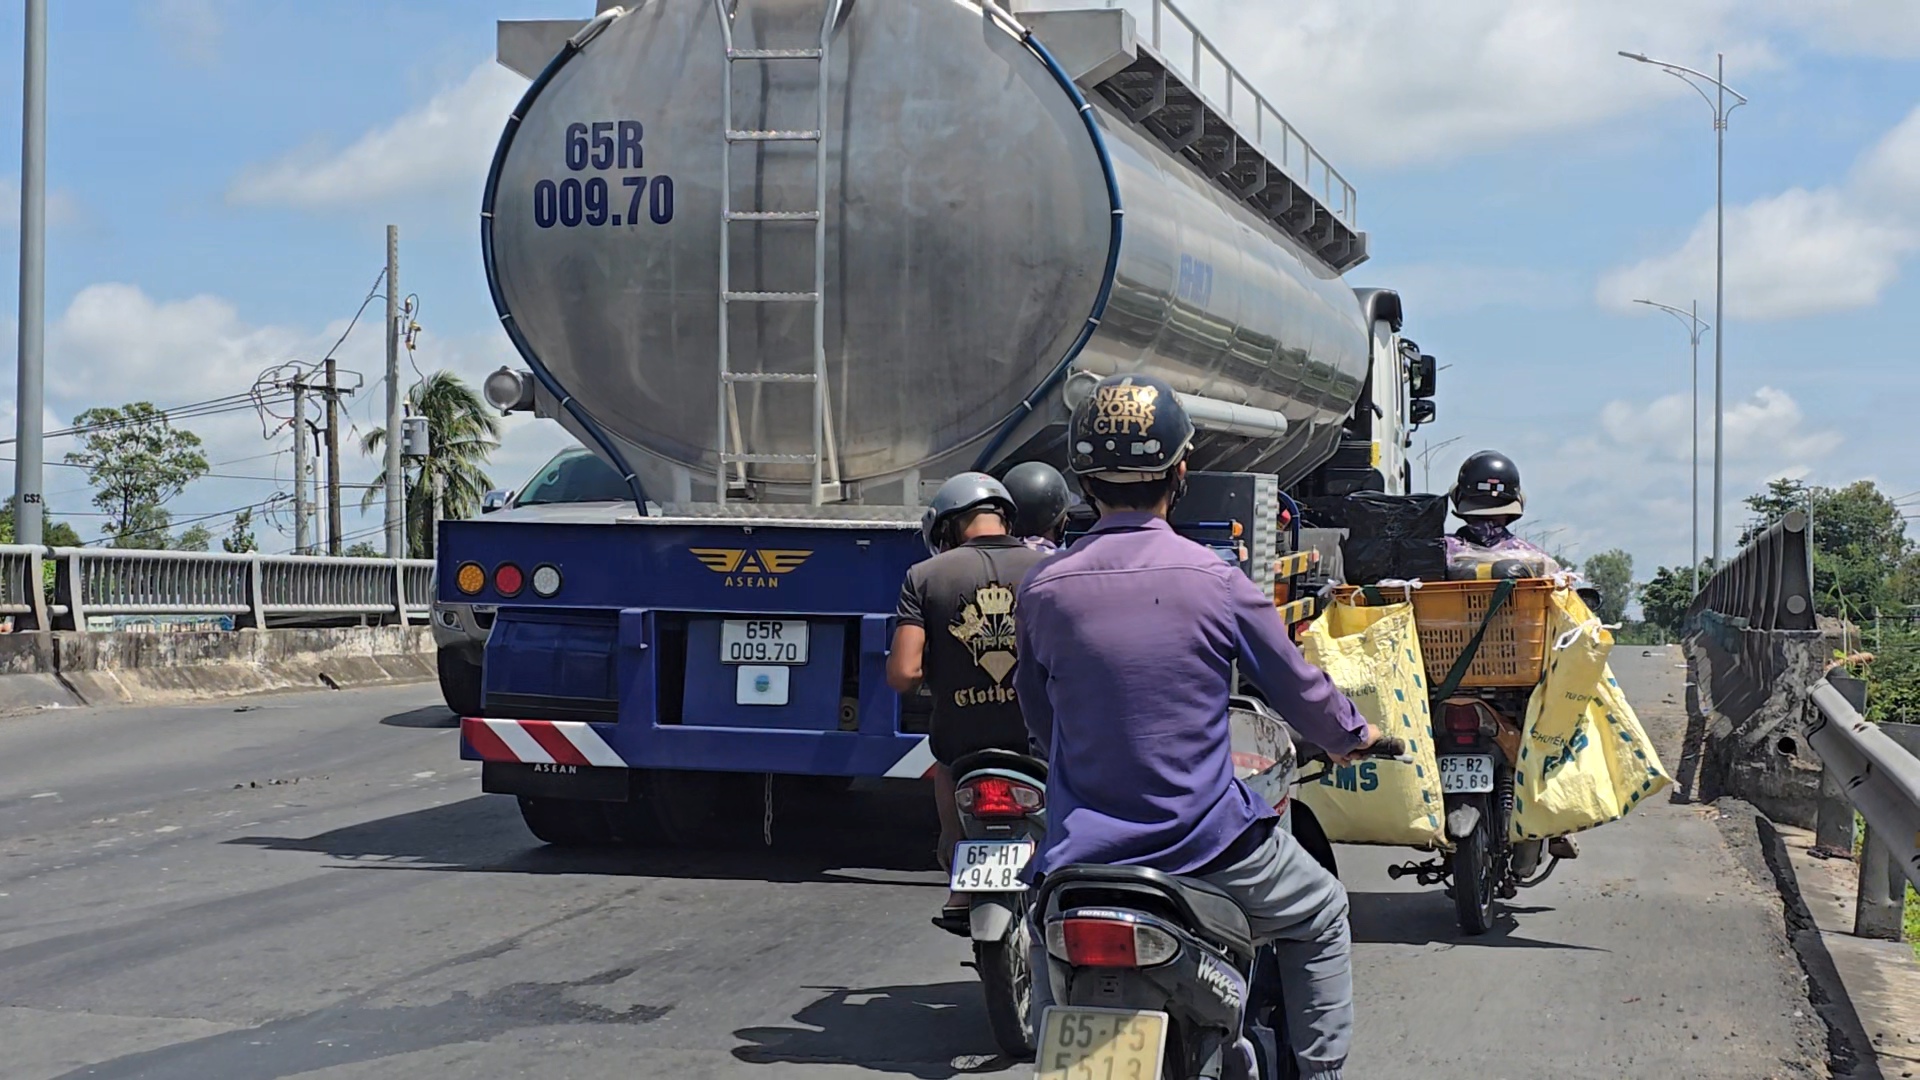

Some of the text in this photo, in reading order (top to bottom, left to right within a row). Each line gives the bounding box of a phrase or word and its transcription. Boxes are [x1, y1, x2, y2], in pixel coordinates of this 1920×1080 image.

[565, 120, 643, 171] 65R
[534, 175, 674, 228] 009.70
[1099, 386, 1158, 402] NEW
[1096, 400, 1156, 420] YORK
[1094, 416, 1154, 436] CITY
[725, 576, 778, 588] ASEAN
[746, 621, 783, 639] 65R
[730, 642, 797, 661] 009.70
[533, 763, 577, 774] ASEAN
[1441, 757, 1483, 772] 65-B2
[1445, 774, 1489, 790] 45.69
[967, 845, 1019, 865] 65-H1
